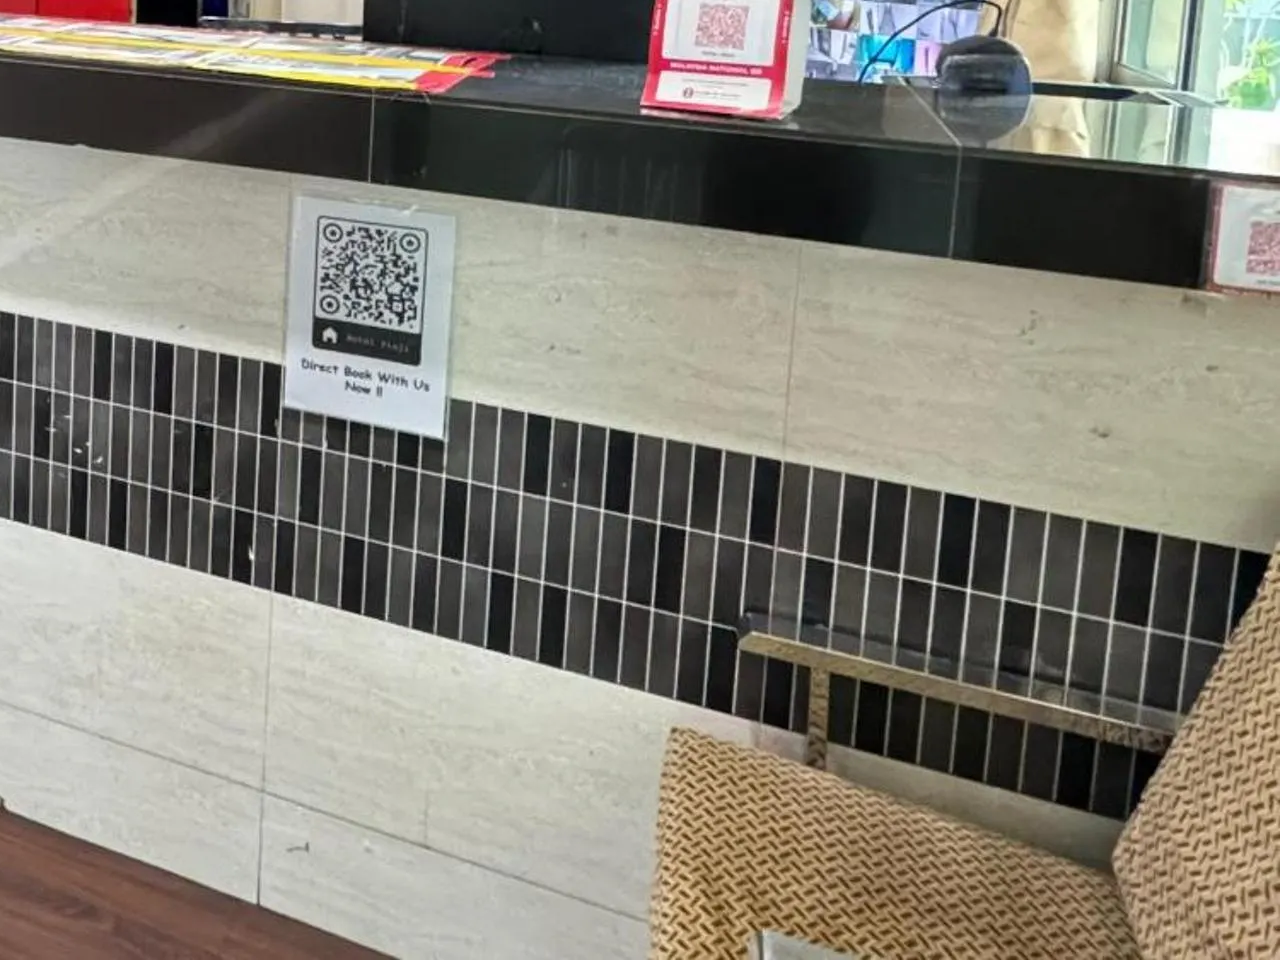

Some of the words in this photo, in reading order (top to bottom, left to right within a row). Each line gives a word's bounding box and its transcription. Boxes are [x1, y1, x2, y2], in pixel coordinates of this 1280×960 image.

[301, 357, 339, 374] Direct
[344, 365, 372, 381] Book
[378, 370, 408, 389] With
[413, 378, 431, 393] Us
[344, 380, 372, 395] Now
